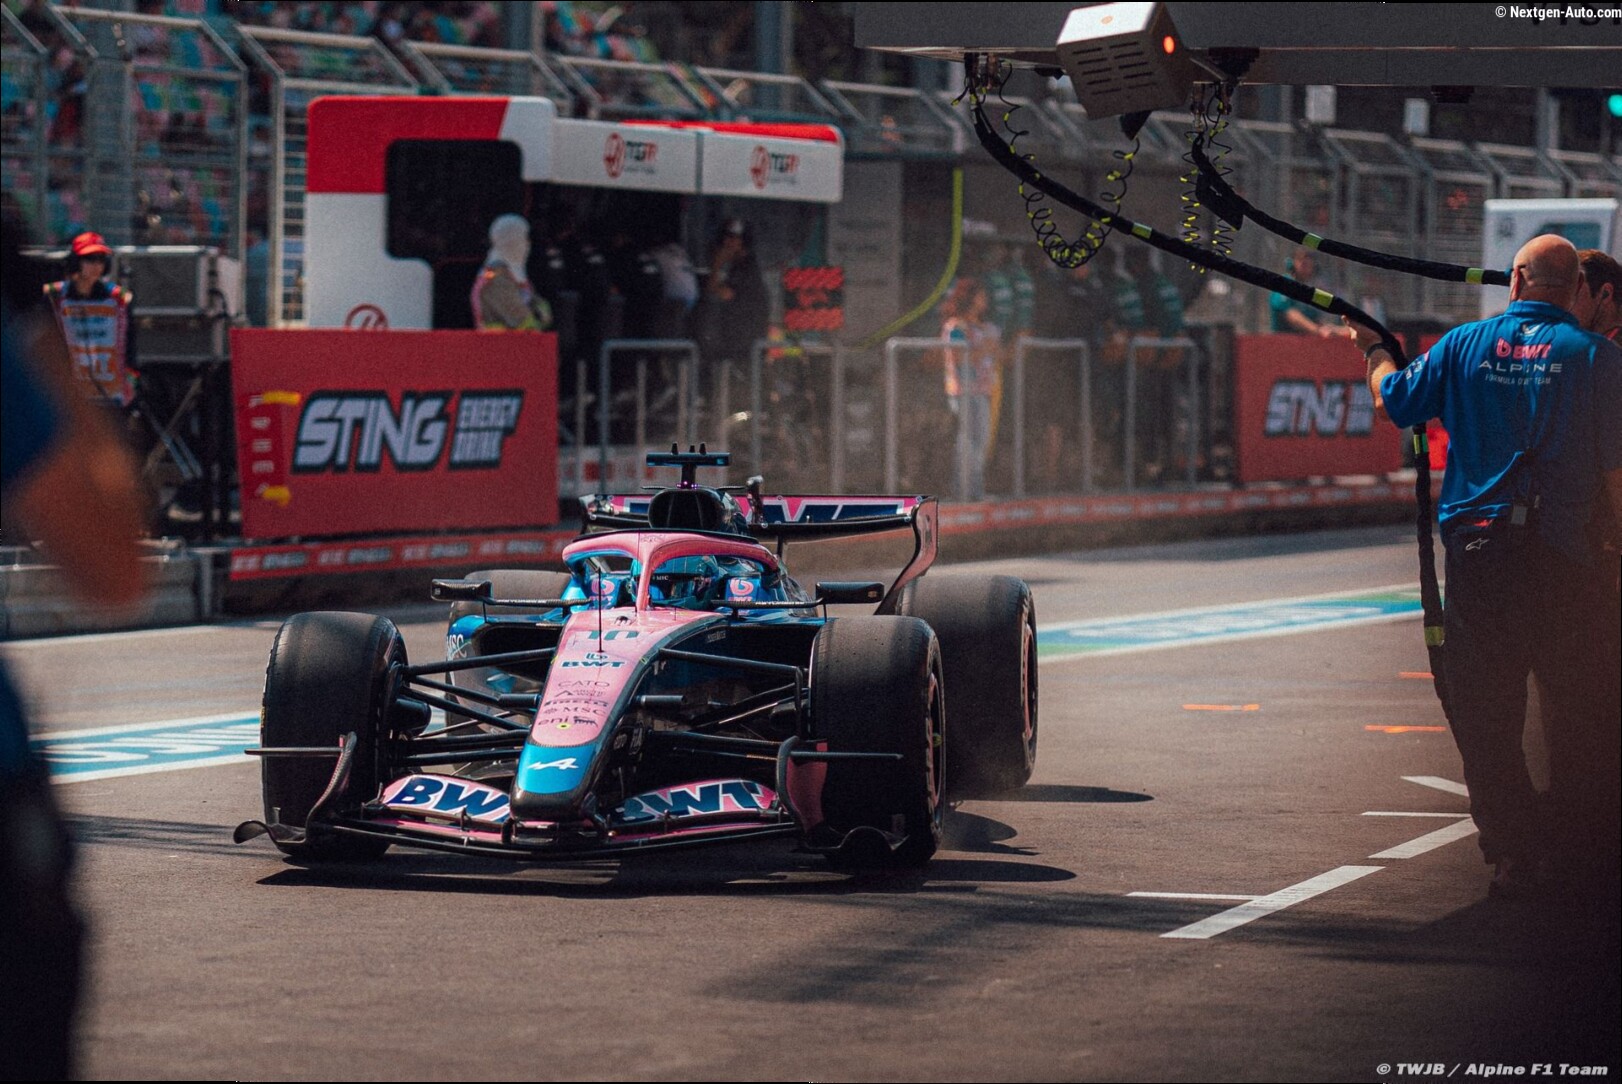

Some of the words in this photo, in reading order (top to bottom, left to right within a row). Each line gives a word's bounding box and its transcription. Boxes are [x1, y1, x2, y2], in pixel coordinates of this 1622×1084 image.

[1479, 360, 1563, 373] ALPINE
[293, 392, 450, 470] STING
[561, 660, 626, 669] BWT
[385, 775, 511, 822] BW
